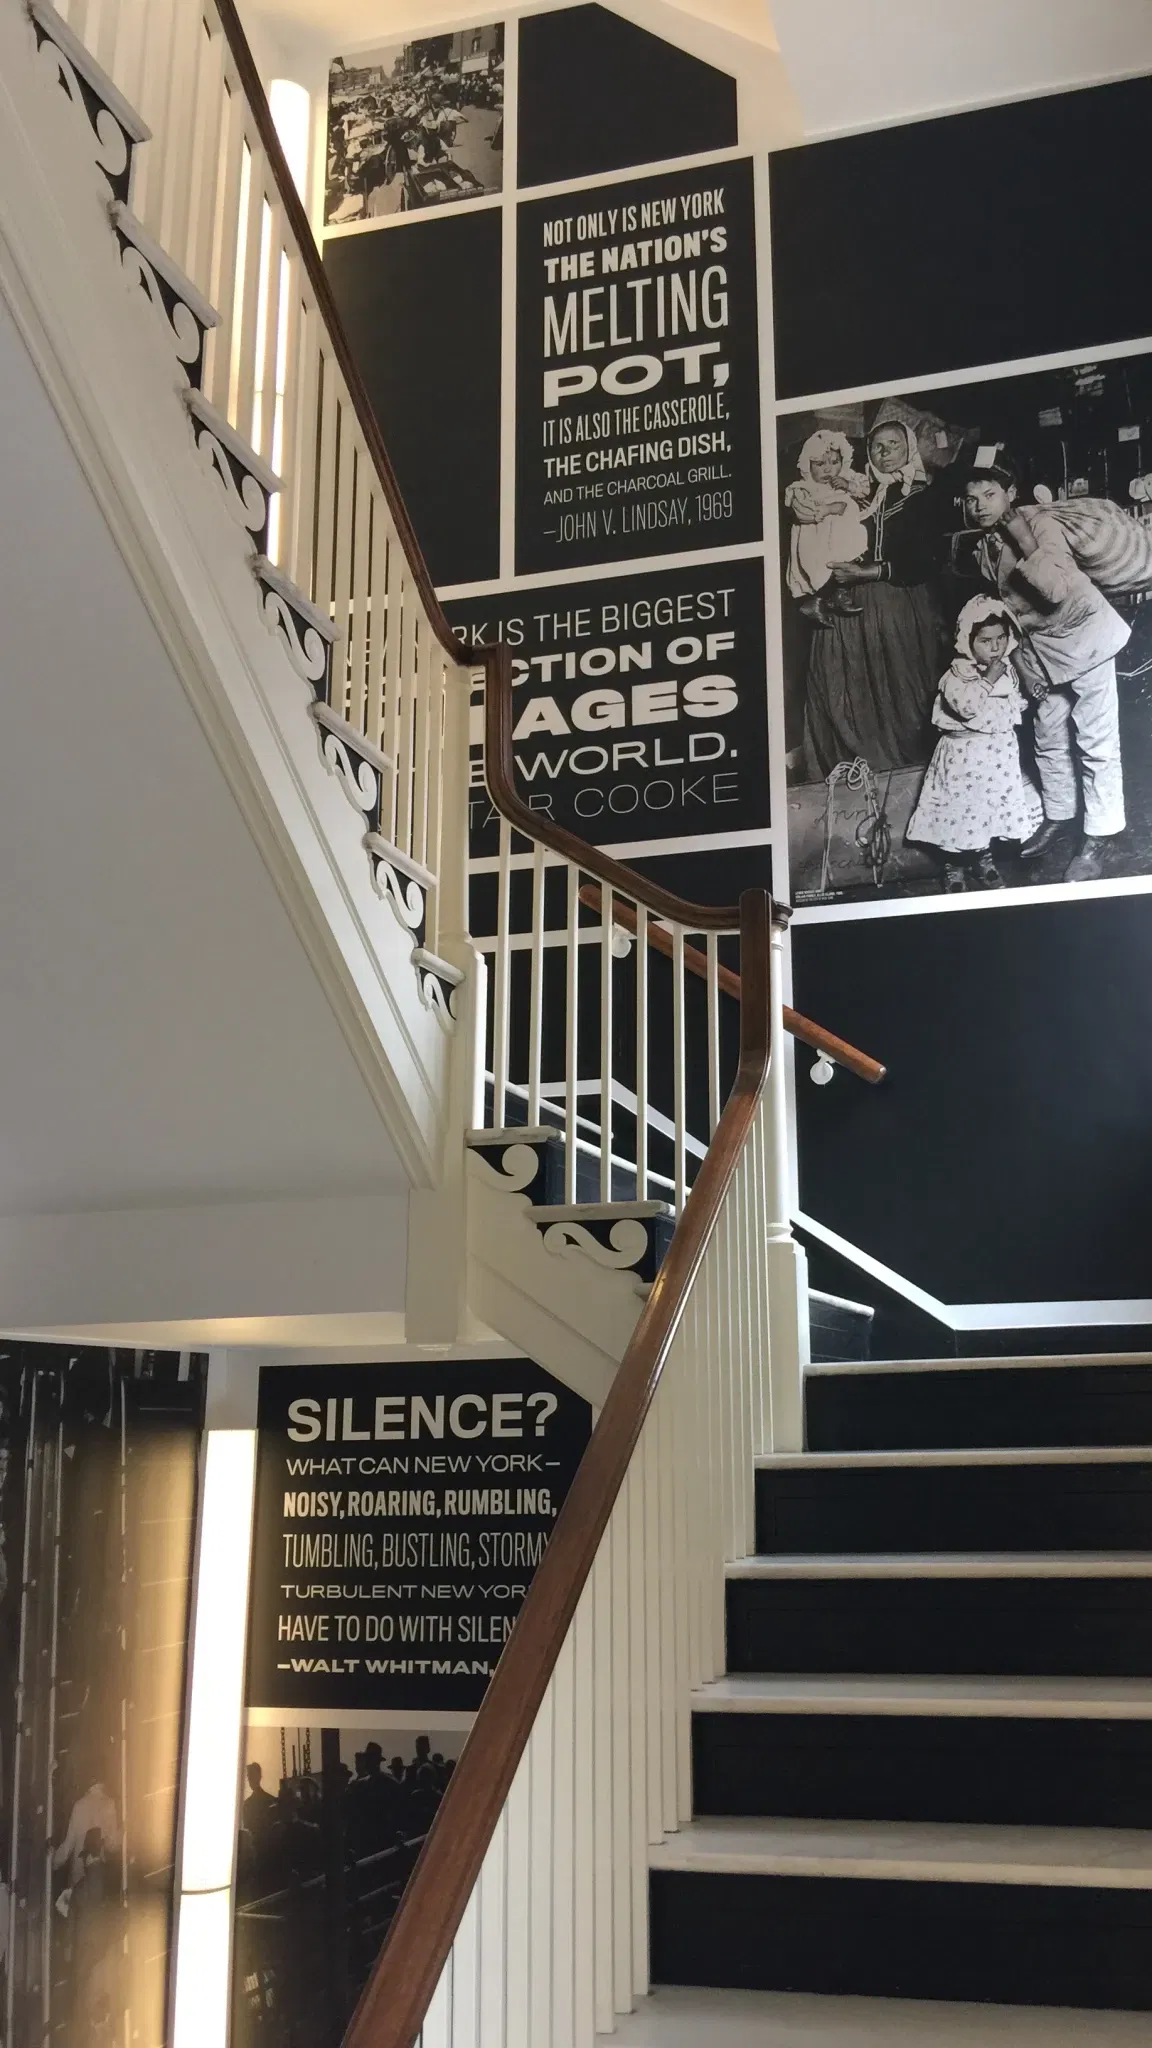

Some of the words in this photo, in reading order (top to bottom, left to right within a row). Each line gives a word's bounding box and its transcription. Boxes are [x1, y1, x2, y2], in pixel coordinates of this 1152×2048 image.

[543, 217, 573, 247] NOT
[577, 209, 618, 241] ONLY
[622, 205, 637, 233] IS
[641, 197, 677, 230] NEW
[680, 188, 725, 220] YORK
[543, 251, 594, 284] THE
[602, 226, 727, 273] NATION'S
[543, 265, 729, 358] MELTING
[543, 342, 730, 408] POT,
[543, 420, 555, 447] IT
[559, 417, 572, 444] IS
[576, 411, 611, 442] ALSO
[614, 406, 640, 435] THE
[643, 392, 730, 432] CASSEROLE,
[543, 454, 582, 479] THE
[585, 440, 673, 473] CHAFING
[678, 431, 732, 458] DISH,
[543, 487, 573, 505] AND
[576, 483, 603, 501] THE
[607, 473, 684, 497] CHARCOAL
[687, 465, 732, 483] GRILL.
[602, 508, 616, 535] V.
[622, 497, 691, 533] LINDSAY,
[695, 490, 733, 521] 1969
[499, 618, 525, 646] IS
[534, 608, 591, 641] THE
[602, 588, 735, 633] BIGGEST
[666, 631, 735, 665] OF
[514, 732, 738, 781] WORLD.
[574, 772, 739, 818] COOKE
[287, 1391, 558, 1442] SILENCE?
[286, 1458, 356, 1476] WHAT
[358, 1457, 408, 1474] CAN
[415, 1456, 472, 1473] NEW
[283, 1491, 344, 1519] NOISY,
[348, 1490, 441, 1518] ROARING,
[445, 1488, 557, 1517] RUMBLING,
[283, 1533, 378, 1571] TUMBLING,
[383, 1532, 475, 1571] BUSTLING,
[280, 1585, 418, 1599] TURBULENT
[421, 1585, 475, 1599] NEW
[477, 1584, 532, 1599] YOR
[278, 1615, 329, 1641] HAVE
[334, 1615, 360, 1641] TO
[366, 1615, 394, 1642] DO
[399, 1615, 452, 1642] WITH
